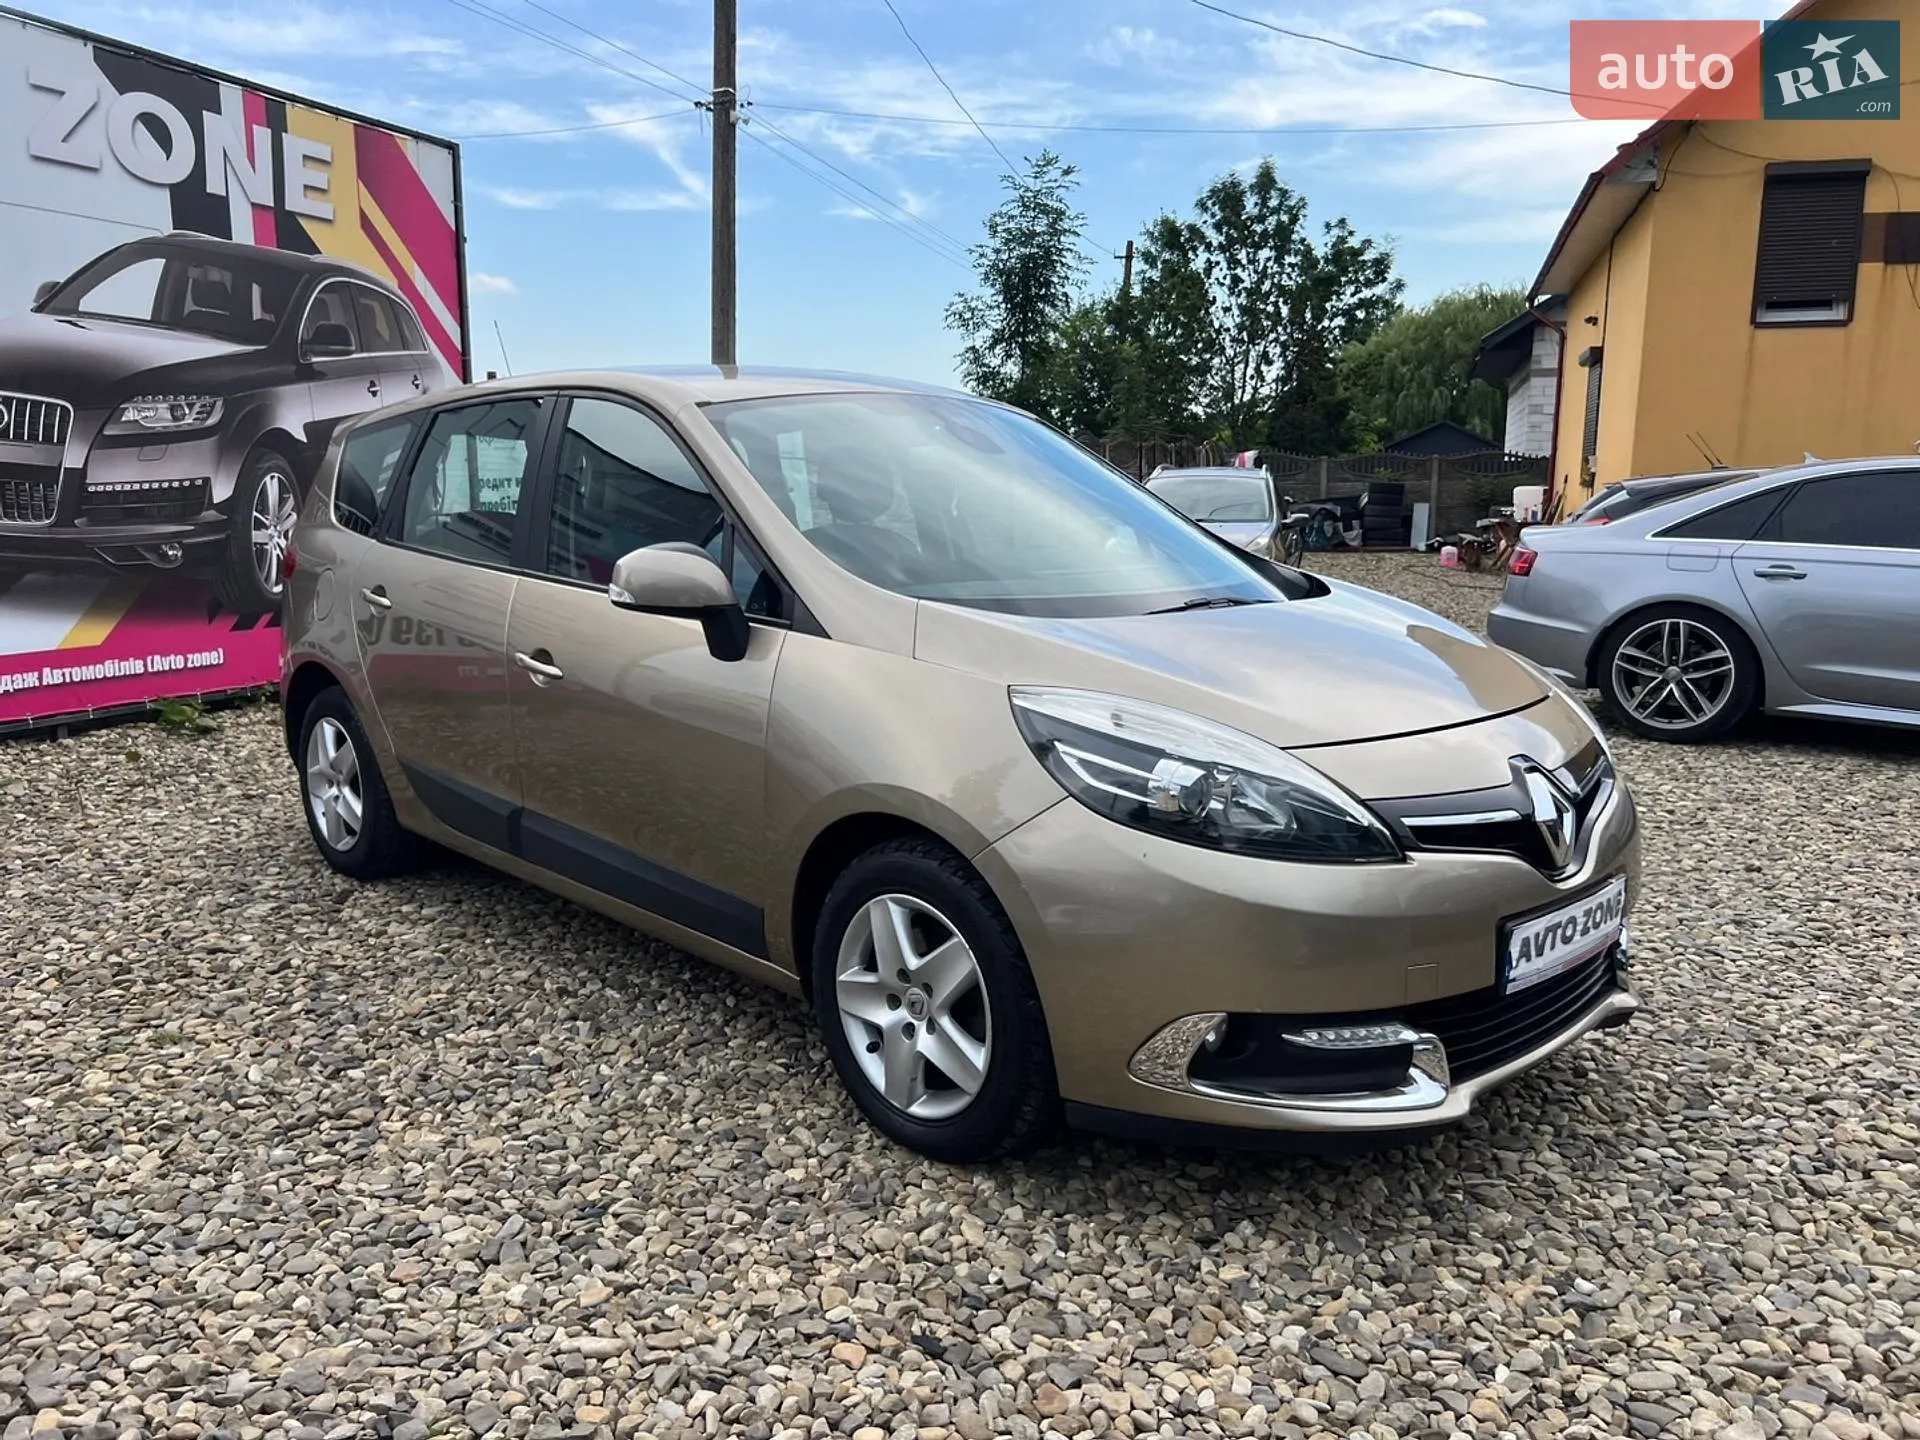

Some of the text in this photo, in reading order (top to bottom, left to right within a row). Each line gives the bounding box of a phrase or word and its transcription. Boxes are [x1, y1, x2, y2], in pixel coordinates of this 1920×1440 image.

[28, 67, 335, 220] ZONE
[42, 657, 144, 685] Автомобілів
[147, 653, 184, 673] (Avto
[187, 648, 224, 668] zone)
[1514, 890, 1622, 967] AVTO ZONE
